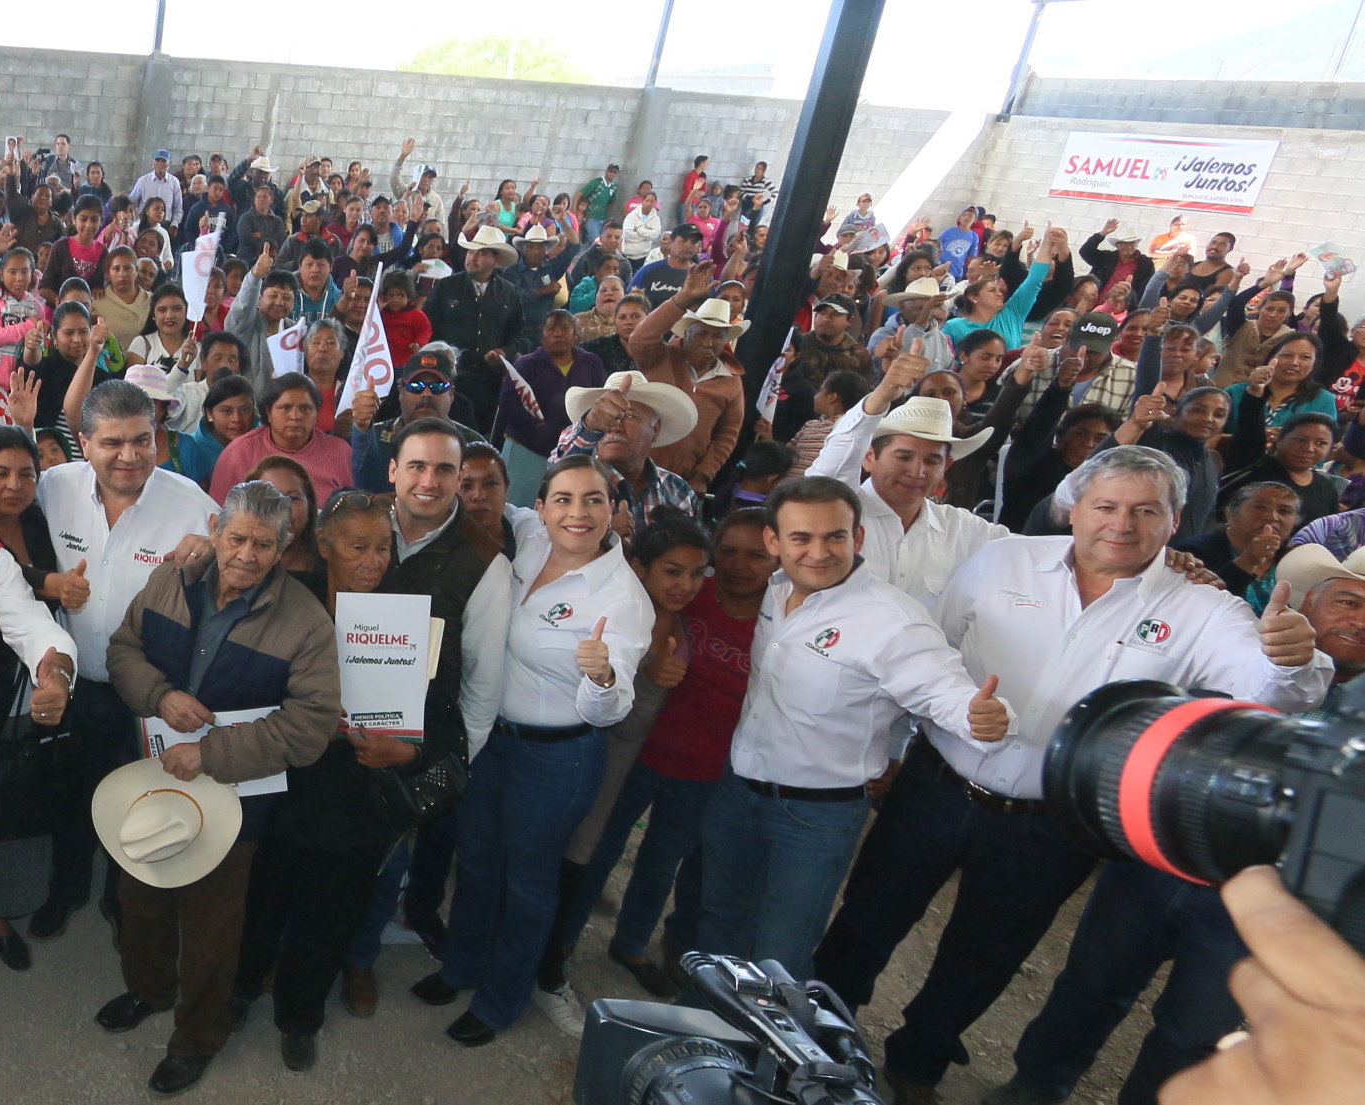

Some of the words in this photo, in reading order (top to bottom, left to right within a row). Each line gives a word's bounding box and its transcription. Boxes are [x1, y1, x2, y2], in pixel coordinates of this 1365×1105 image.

[1125, 147, 1176, 159] DIPUTADO
[1064, 154, 1151, 181] SAMUEL
[1173, 154, 1258, 177] ¡Jalemos
[1069, 175, 1112, 189] Rodríguez
[1183, 173, 1258, 194] Juntos!
[1080, 322, 1112, 336] Jeep
[139, 547, 157, 556] Miguel
[354, 624, 380, 633] Miguel
[1138, 622, 1167, 639] PRI
[346, 632, 409, 646] RIQUELME
[345, 654, 383, 665] ¡Jalemos
[383, 656, 417, 667] Juntos!
[355, 713, 374, 721] MENOS
